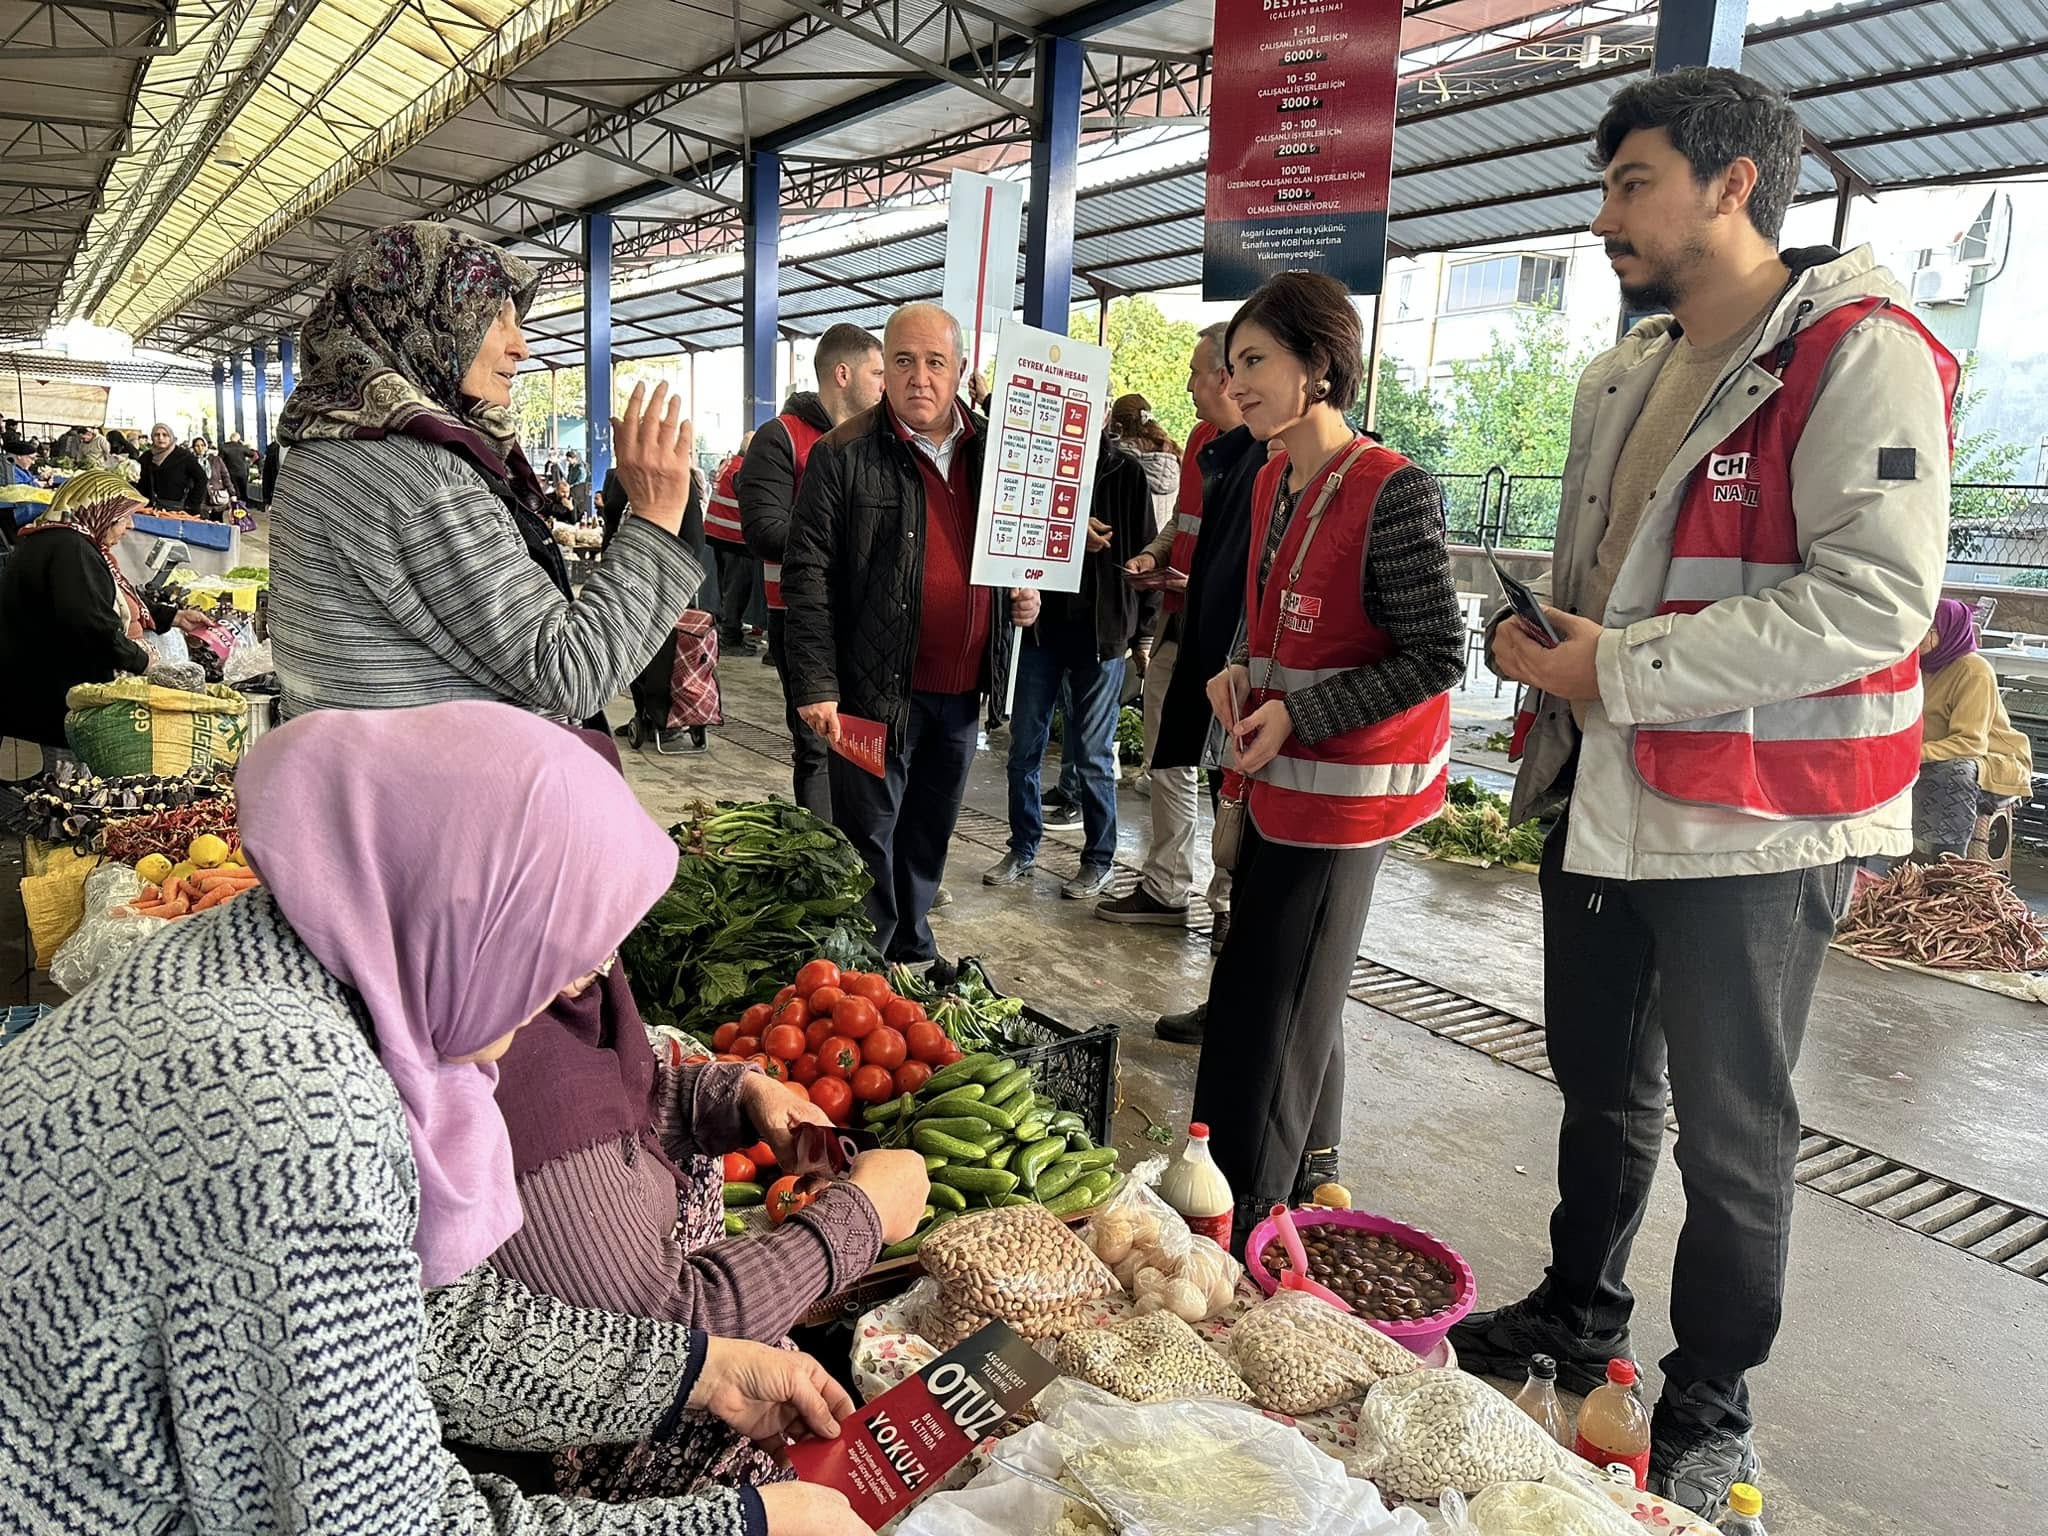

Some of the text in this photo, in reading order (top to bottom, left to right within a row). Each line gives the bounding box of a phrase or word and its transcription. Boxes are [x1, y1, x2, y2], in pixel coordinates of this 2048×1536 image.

[1269, 8, 1307, 20] (ÇALIŞAN
[1293, 27, 1298, 36] 1
[1305, 25, 1316, 35] 10
[1284, 49, 1313, 63] 6000
[1286, 74, 1297, 84] 10
[1304, 72, 1317, 83] 50
[1281, 96, 1310, 109] 3000
[1280, 121, 1293, 131] 50
[1300, 119, 1317, 130] 100
[1278, 143, 1307, 155] 2000
[1293, 175, 1313, 185] OLAN
[1277, 188, 1303, 199] 1500
[1247, 206, 1286, 215] OLMASINI
[1240, 229, 1265, 240] Asgari
[1266, 226, 1294, 237] ücretin
[1294, 224, 1313, 236] artış
[1242, 240, 1270, 250] Esnafın
[1316, 236, 1342, 246] sırtına
[1018, 357, 1088, 383] ÇEYREK ALTIN HESABI
[1009, 404, 1023, 416] 14,5
[1070, 408, 1076, 419] 7
[1007, 449, 1013, 458] 8
[1060, 449, 1073, 463] 5,5
[1003, 493, 1009, 502] 7
[1030, 497, 1035, 506] 3
[1057, 491, 1064, 502] 4
[1021, 536, 1036, 546] 0,25
[1049, 530, 1063, 541] 1,25
[1024, 568, 1043, 580] CHP
[129, 708, 150, 732] GÖ
[926, 1362, 1007, 1442] OTUZ
[921, 1412, 946, 1440] BUNUN
[909, 1418, 937, 1451] ALTINDA
[868, 1411, 930, 1490] YOKUZ!
